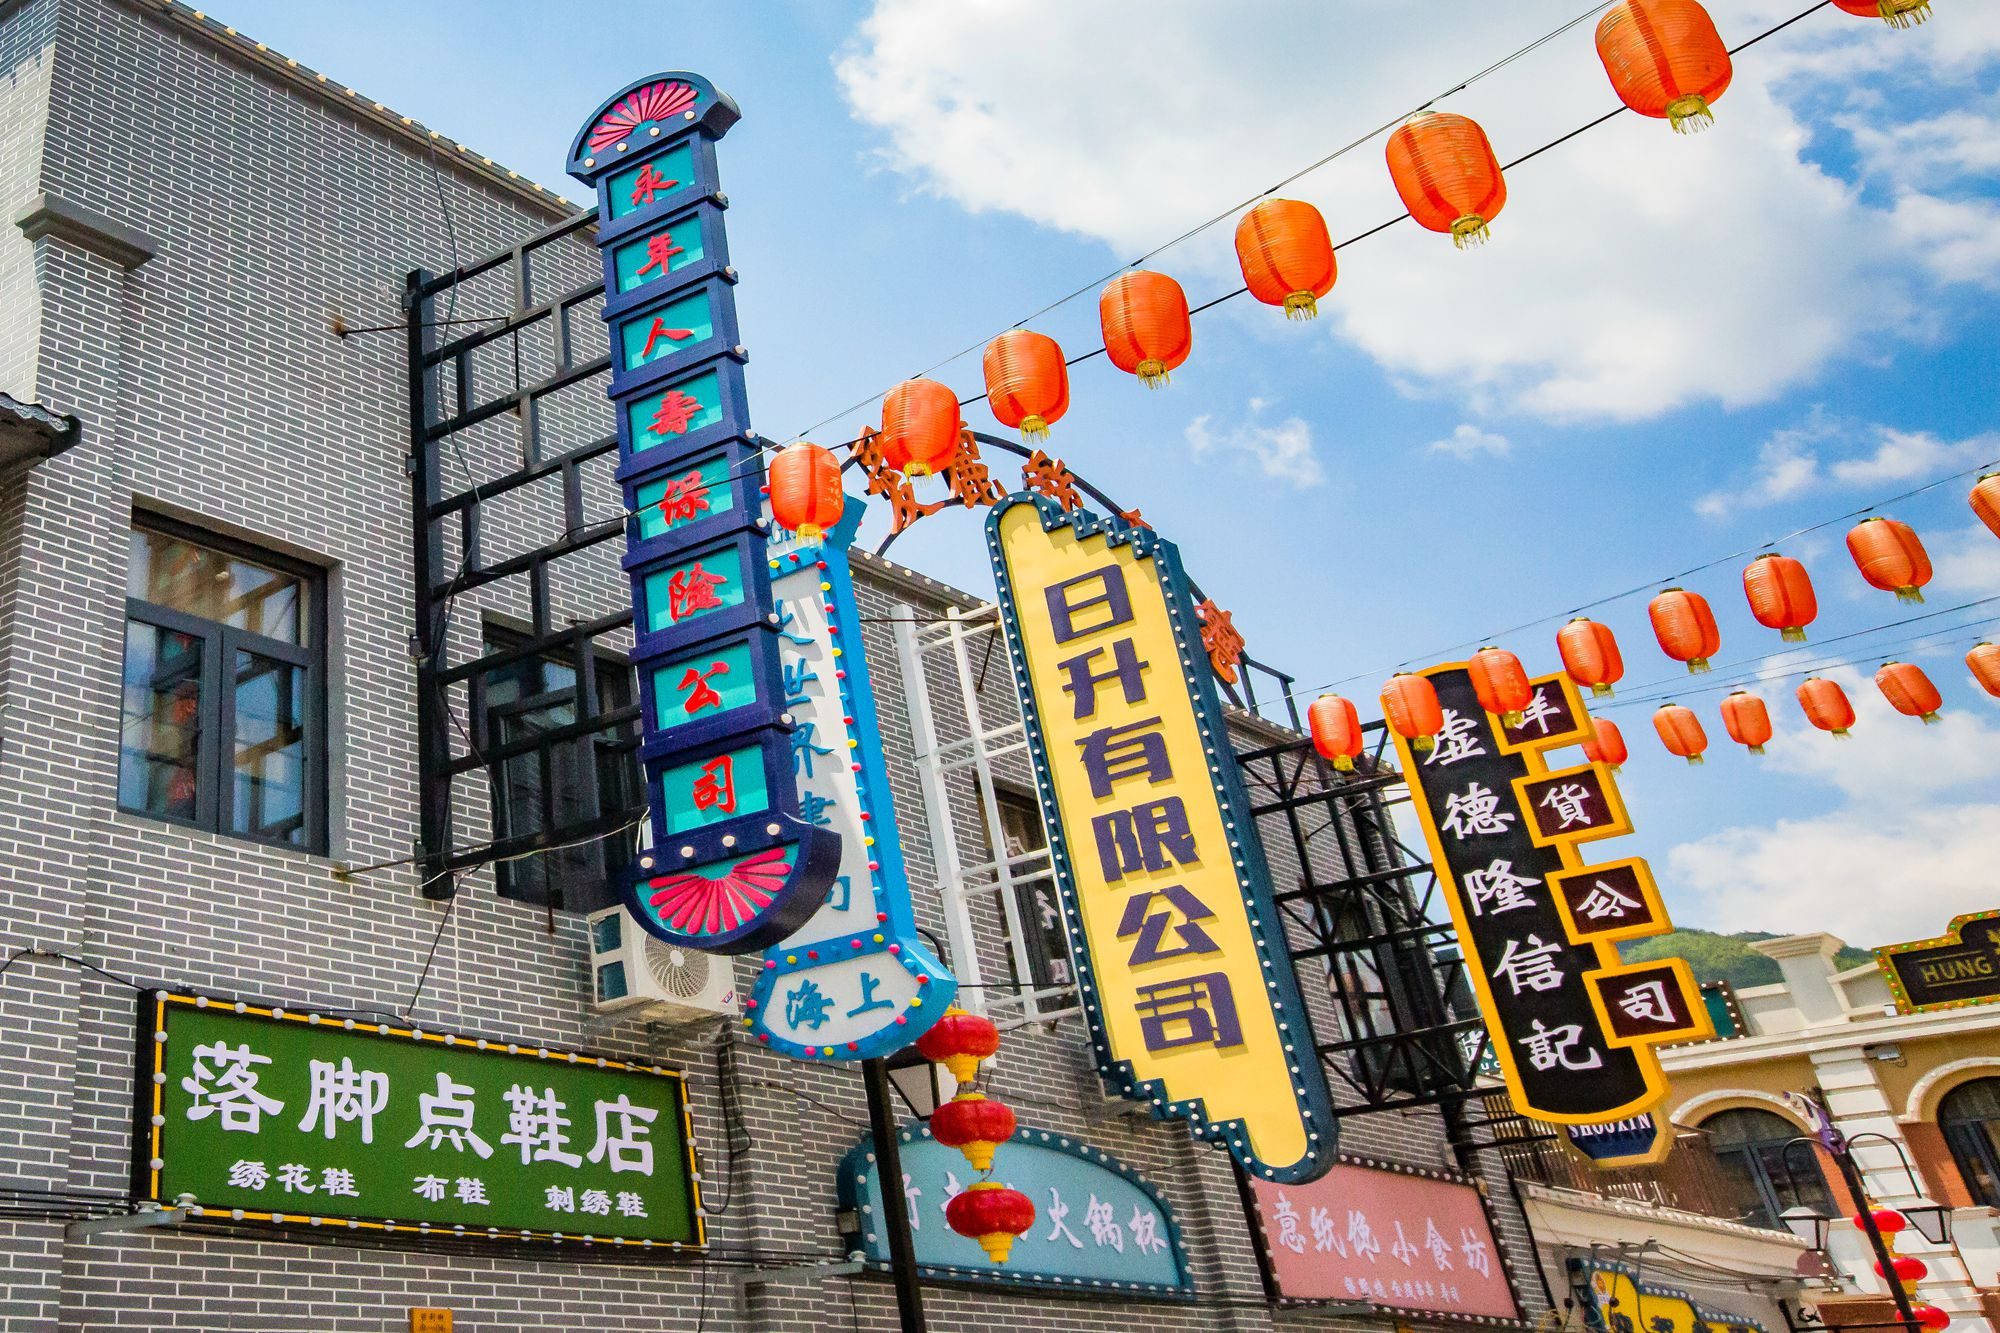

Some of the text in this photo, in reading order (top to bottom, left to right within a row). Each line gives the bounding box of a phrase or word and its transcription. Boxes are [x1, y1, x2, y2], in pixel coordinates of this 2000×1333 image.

[1044, 563, 1245, 1053] 日升有限公司
[1919, 955, 1993, 983] HUNG
[181, 1039, 660, 1178] 落脚点鞋店
[226, 1158, 650, 1219] 绣花鞋 布鞋 刺绣鞋
